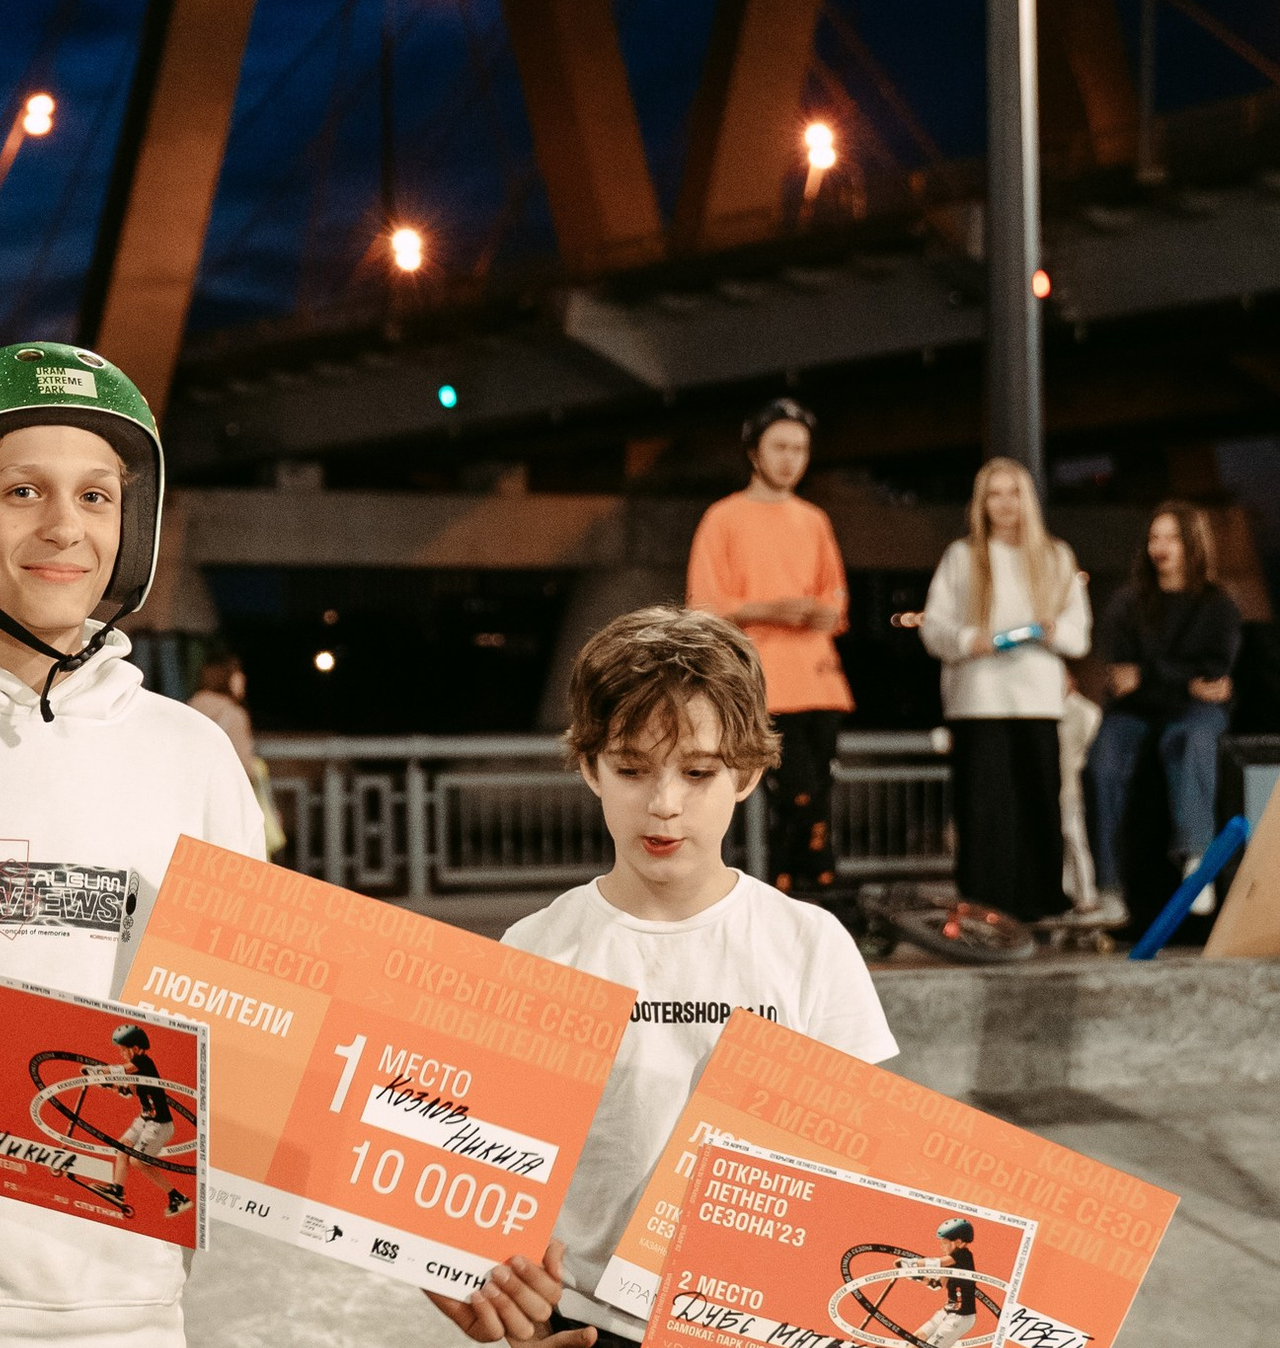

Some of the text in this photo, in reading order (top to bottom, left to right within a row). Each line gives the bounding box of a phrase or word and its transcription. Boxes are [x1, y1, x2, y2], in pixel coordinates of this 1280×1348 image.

[36, 367, 66, 377] URAM
[37, 376, 83, 387] EXTREME
[38, 385, 66, 395] PARK
[33, 871, 121, 892] ALBUM
[29, 928, 71, 937] of memories
[325, 889, 436, 950] СЕЗОНА
[499, 950, 609, 1011] КАЗАНЬ
[248, 904, 329, 956] ПАРК
[384, 949, 536, 1023] ОТКРЫТИЕ
[143, 965, 295, 1038] ЛЮБИТЕЛИ
[207, 925, 571, 1076] 1 МЕСТО ЛЮБИТЕЛИ
[630, 1001, 731, 1024] OOTERSHOP
[329, 1033, 472, 1114] 1 МЕСТО
[747, 1090, 769, 1117] 2
[772, 1101, 871, 1161] МЕСТО
[869, 1070, 978, 1139] СЕЗОНА
[1035, 1142, 1148, 1211] КАЗАНЬ
[794, 1072, 869, 1128] ПАРК
[922, 1132, 1074, 1218] ОТКРЫТИЕ
[349, 1139, 539, 1236] 10 000₽
[712, 1158, 816, 1201] ОТКРЫТИЕ
[704, 1179, 788, 1218] ЛЕТНЕГО
[698, 1202, 806, 1247] СЕЗОНА'23
[371, 1238, 400, 1260] KSS
[425, 1261, 487, 1291] СПУТН
[864, 1270, 900, 1283] KICKSCOOTER
[917, 1268, 953, 1276] KICKSCOOTER
[971, 1273, 1007, 1289] KICKSCOOTER
[678, 1270, 693, 1291] 2
[696, 1274, 764, 1310] МЕСТО
[832, 1287, 848, 1319] KICKSCOOTER
[666, 1319, 715, 1343] САМОКАТ:
